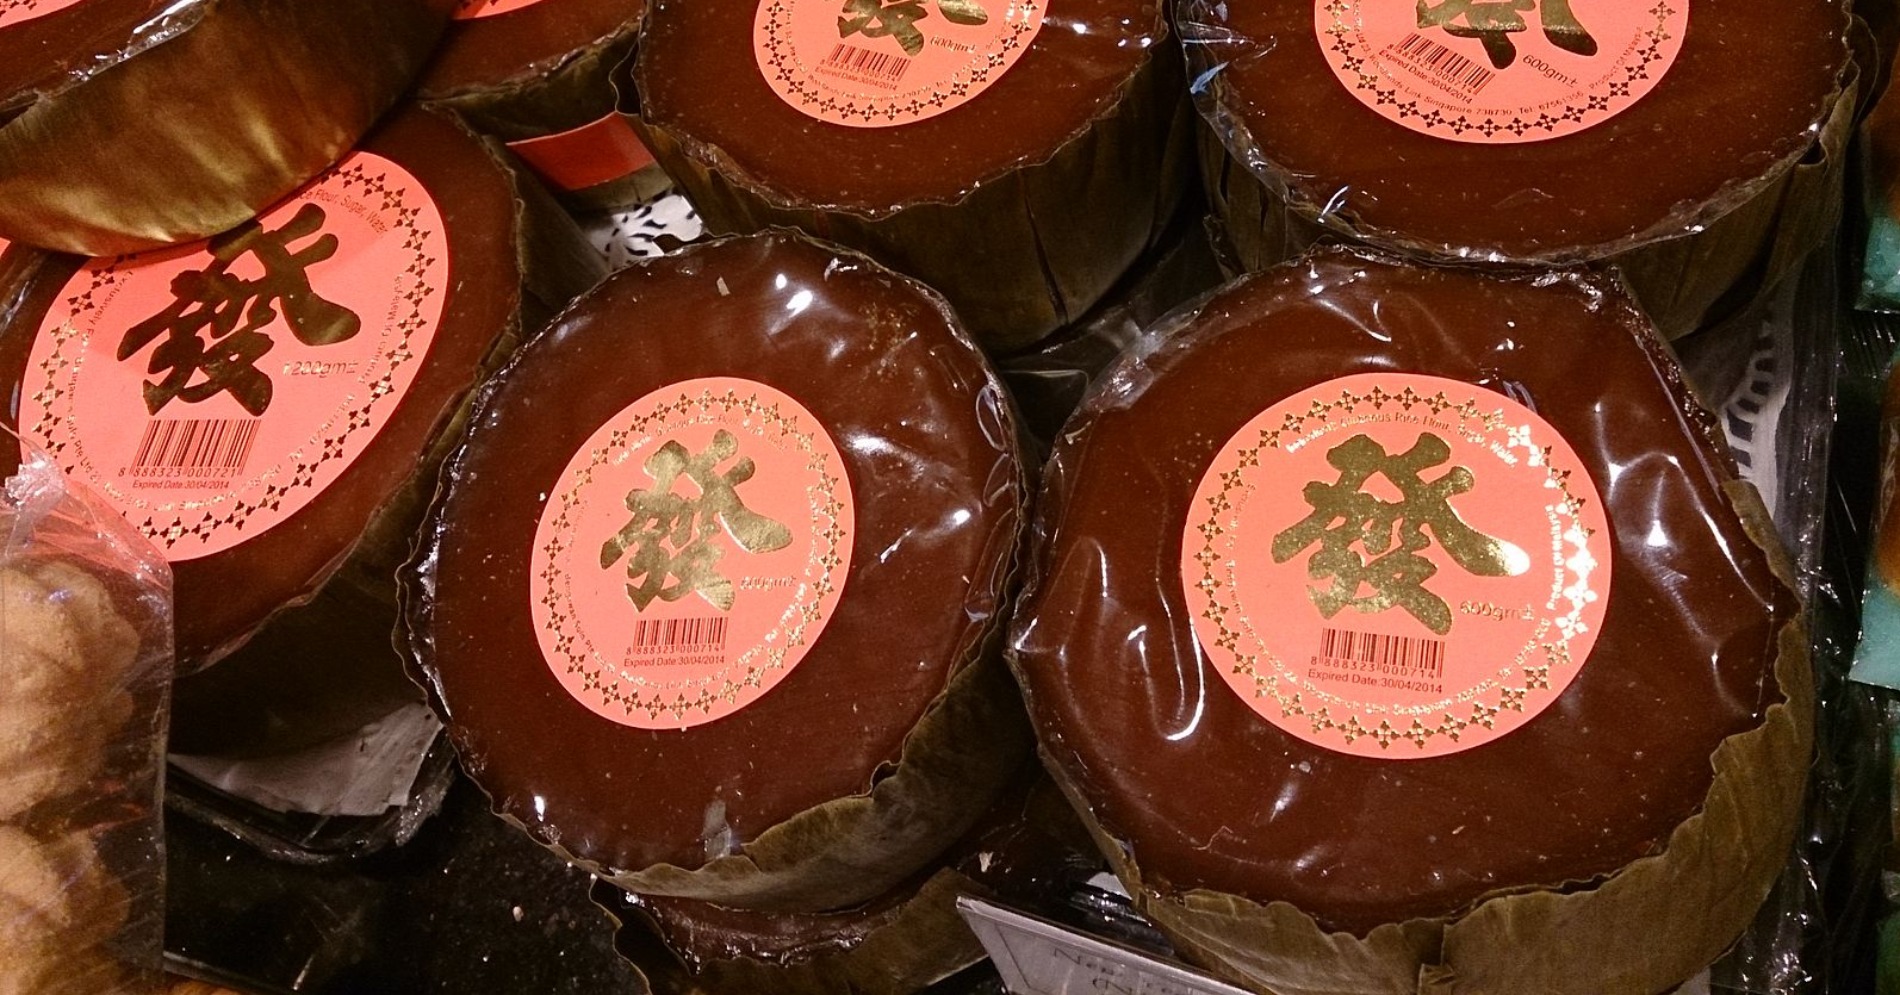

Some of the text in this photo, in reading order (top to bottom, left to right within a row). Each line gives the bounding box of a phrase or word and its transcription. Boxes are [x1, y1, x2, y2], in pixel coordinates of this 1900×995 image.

[132, 480, 163, 490] Expired
[600, 429, 793, 613] 發
[1271, 432, 1530, 636] 發
[1460, 600, 1534, 621] 600gm±
[624, 658, 655, 668] Expired
[1308, 668, 1349, 684] Expired
